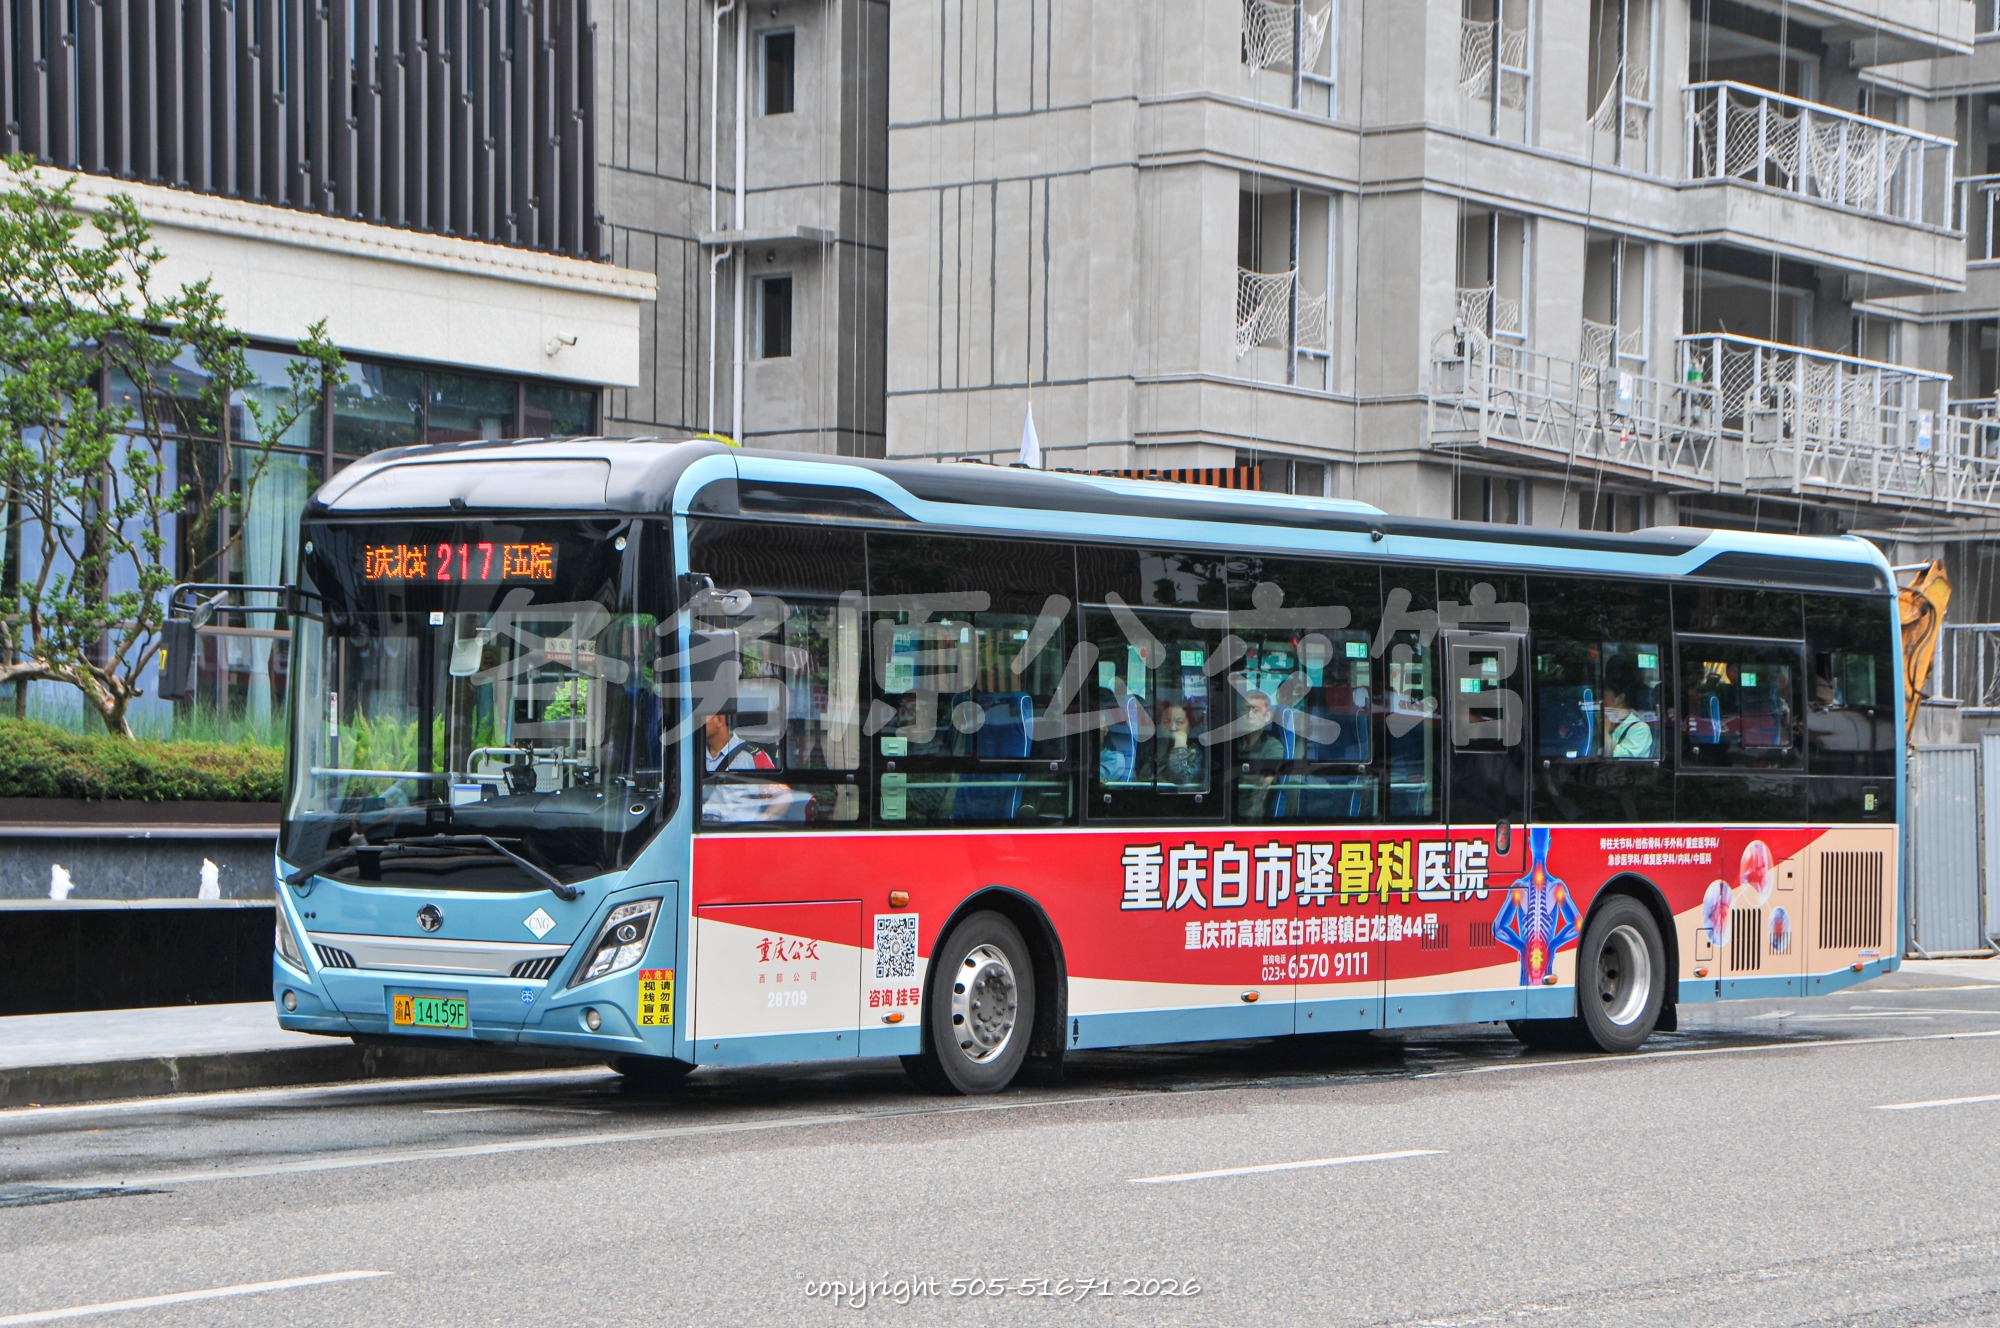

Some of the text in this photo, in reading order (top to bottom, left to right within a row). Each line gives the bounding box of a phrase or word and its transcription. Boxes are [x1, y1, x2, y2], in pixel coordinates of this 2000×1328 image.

[436, 542, 494, 580] 217
[1120, 839, 1490, 912] 重庆白市驿骨科医院
[528, 917, 550, 930] CNG
[1184, 913, 1439, 950] 重庆市高新区白市驿镇白龙路44号
[756, 936, 820, 963] 重庆公交
[1262, 954, 1287, 965] 咨询电话
[654, 970, 673, 980] 危险
[759, 971, 817, 984] 西部公司
[1288, 953, 1329, 979] 6570
[1334, 952, 1368, 977] 9111
[643, 981, 656, 1024] 视线盲区
[659, 981, 671, 1024] 请勿靠近
[767, 991, 807, 1008] 28709
